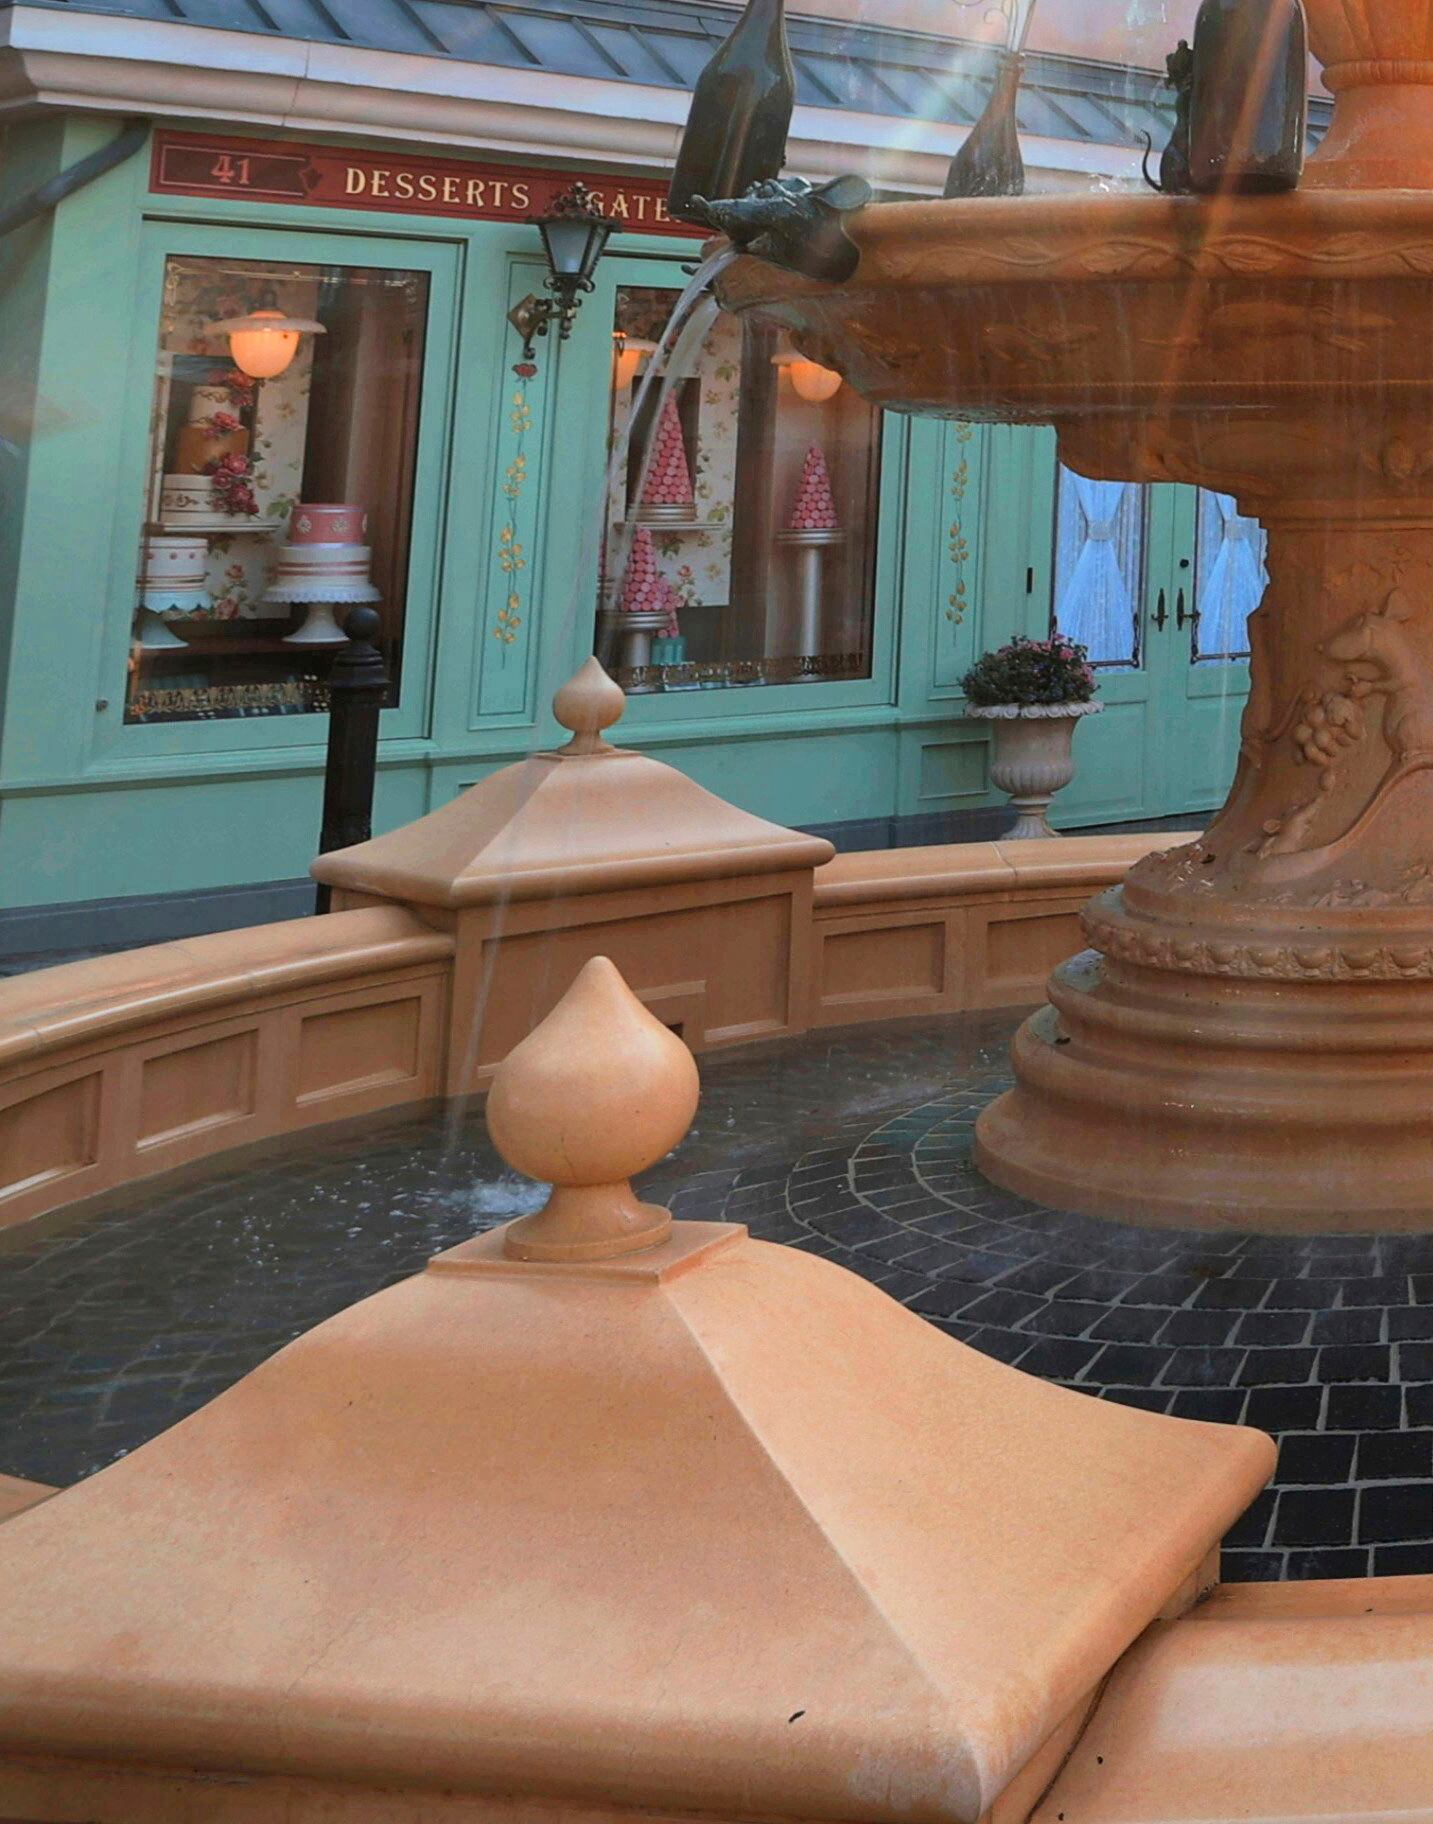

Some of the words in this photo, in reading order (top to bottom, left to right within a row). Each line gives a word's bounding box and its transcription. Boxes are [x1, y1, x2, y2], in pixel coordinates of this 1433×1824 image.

[210, 154, 250, 185] 41
[345, 167, 530, 209] DESSERTS
[585, 188, 682, 223] GÂTE
